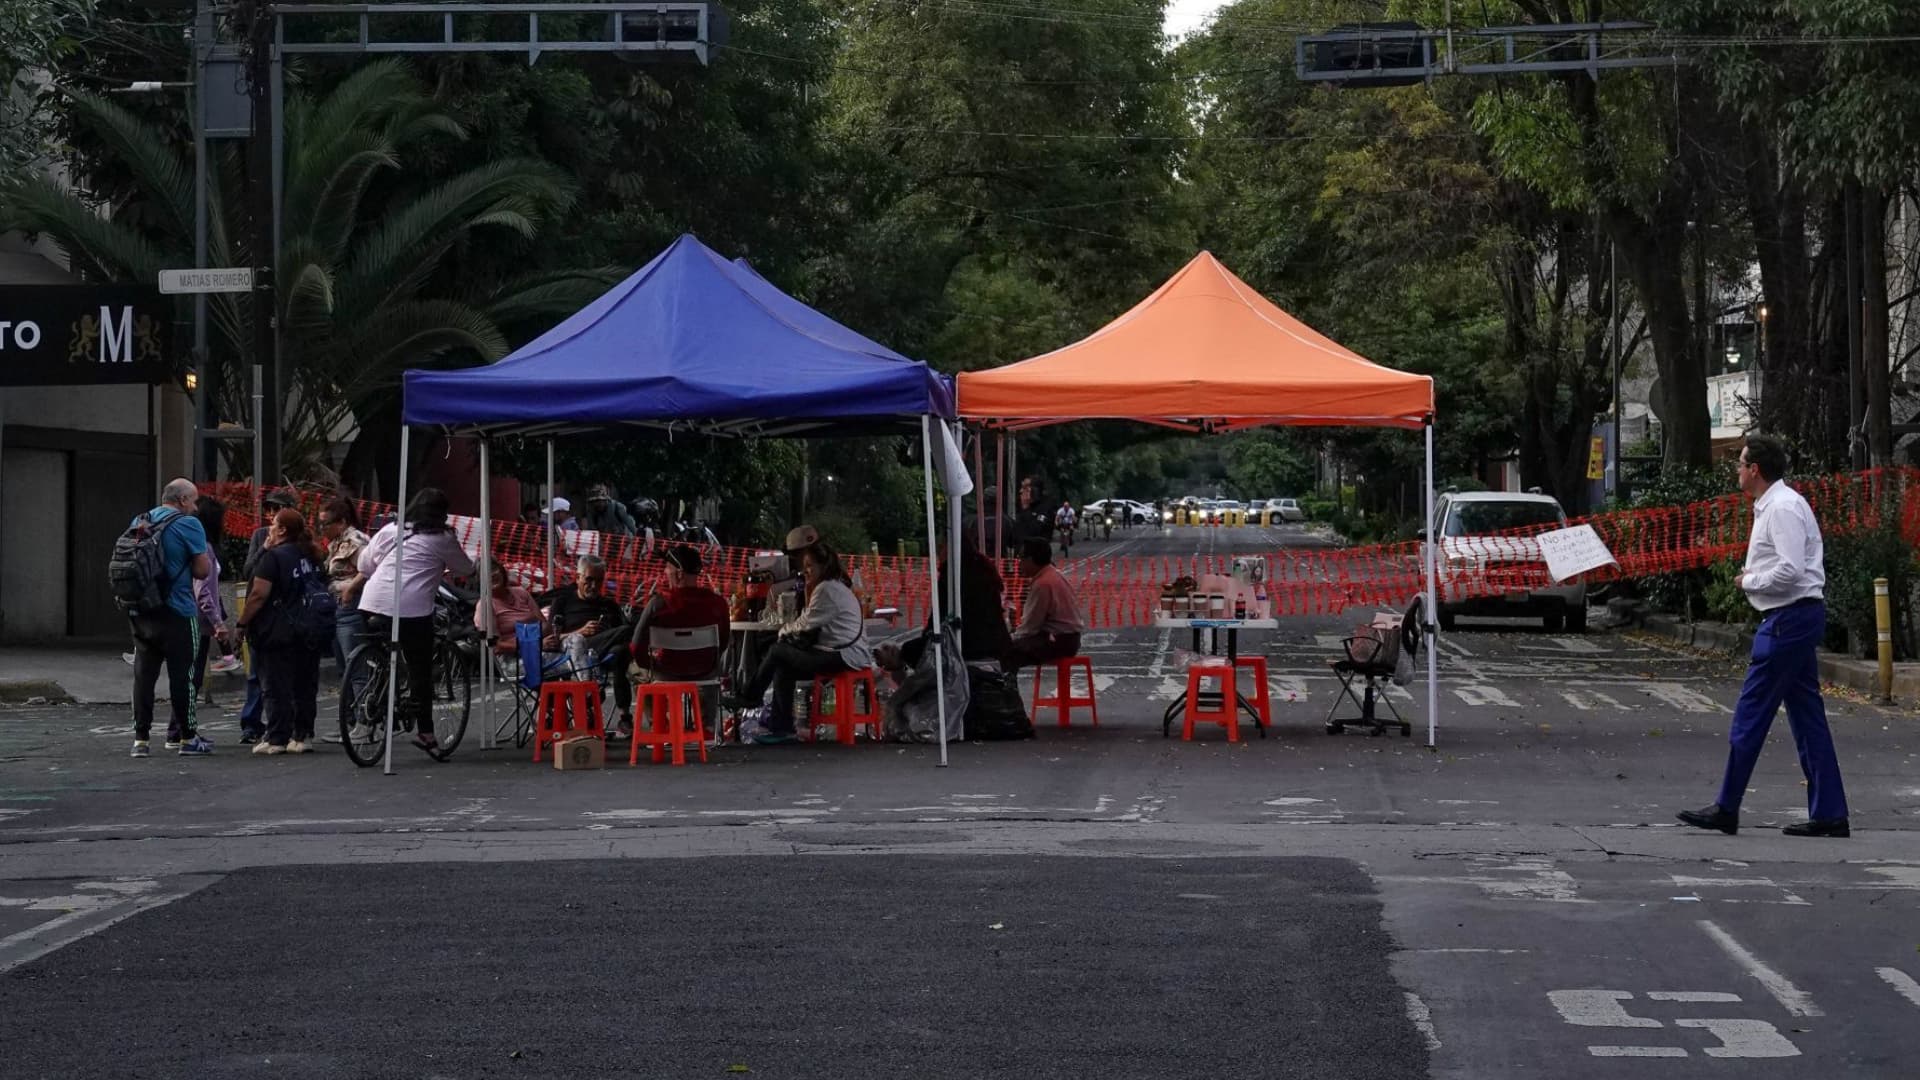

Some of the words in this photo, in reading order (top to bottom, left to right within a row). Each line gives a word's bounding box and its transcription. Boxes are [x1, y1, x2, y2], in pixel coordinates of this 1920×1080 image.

[179, 273, 211, 288] MATIAS
[213, 271, 251, 287] ROMERO
[99, 305, 134, 363] M
